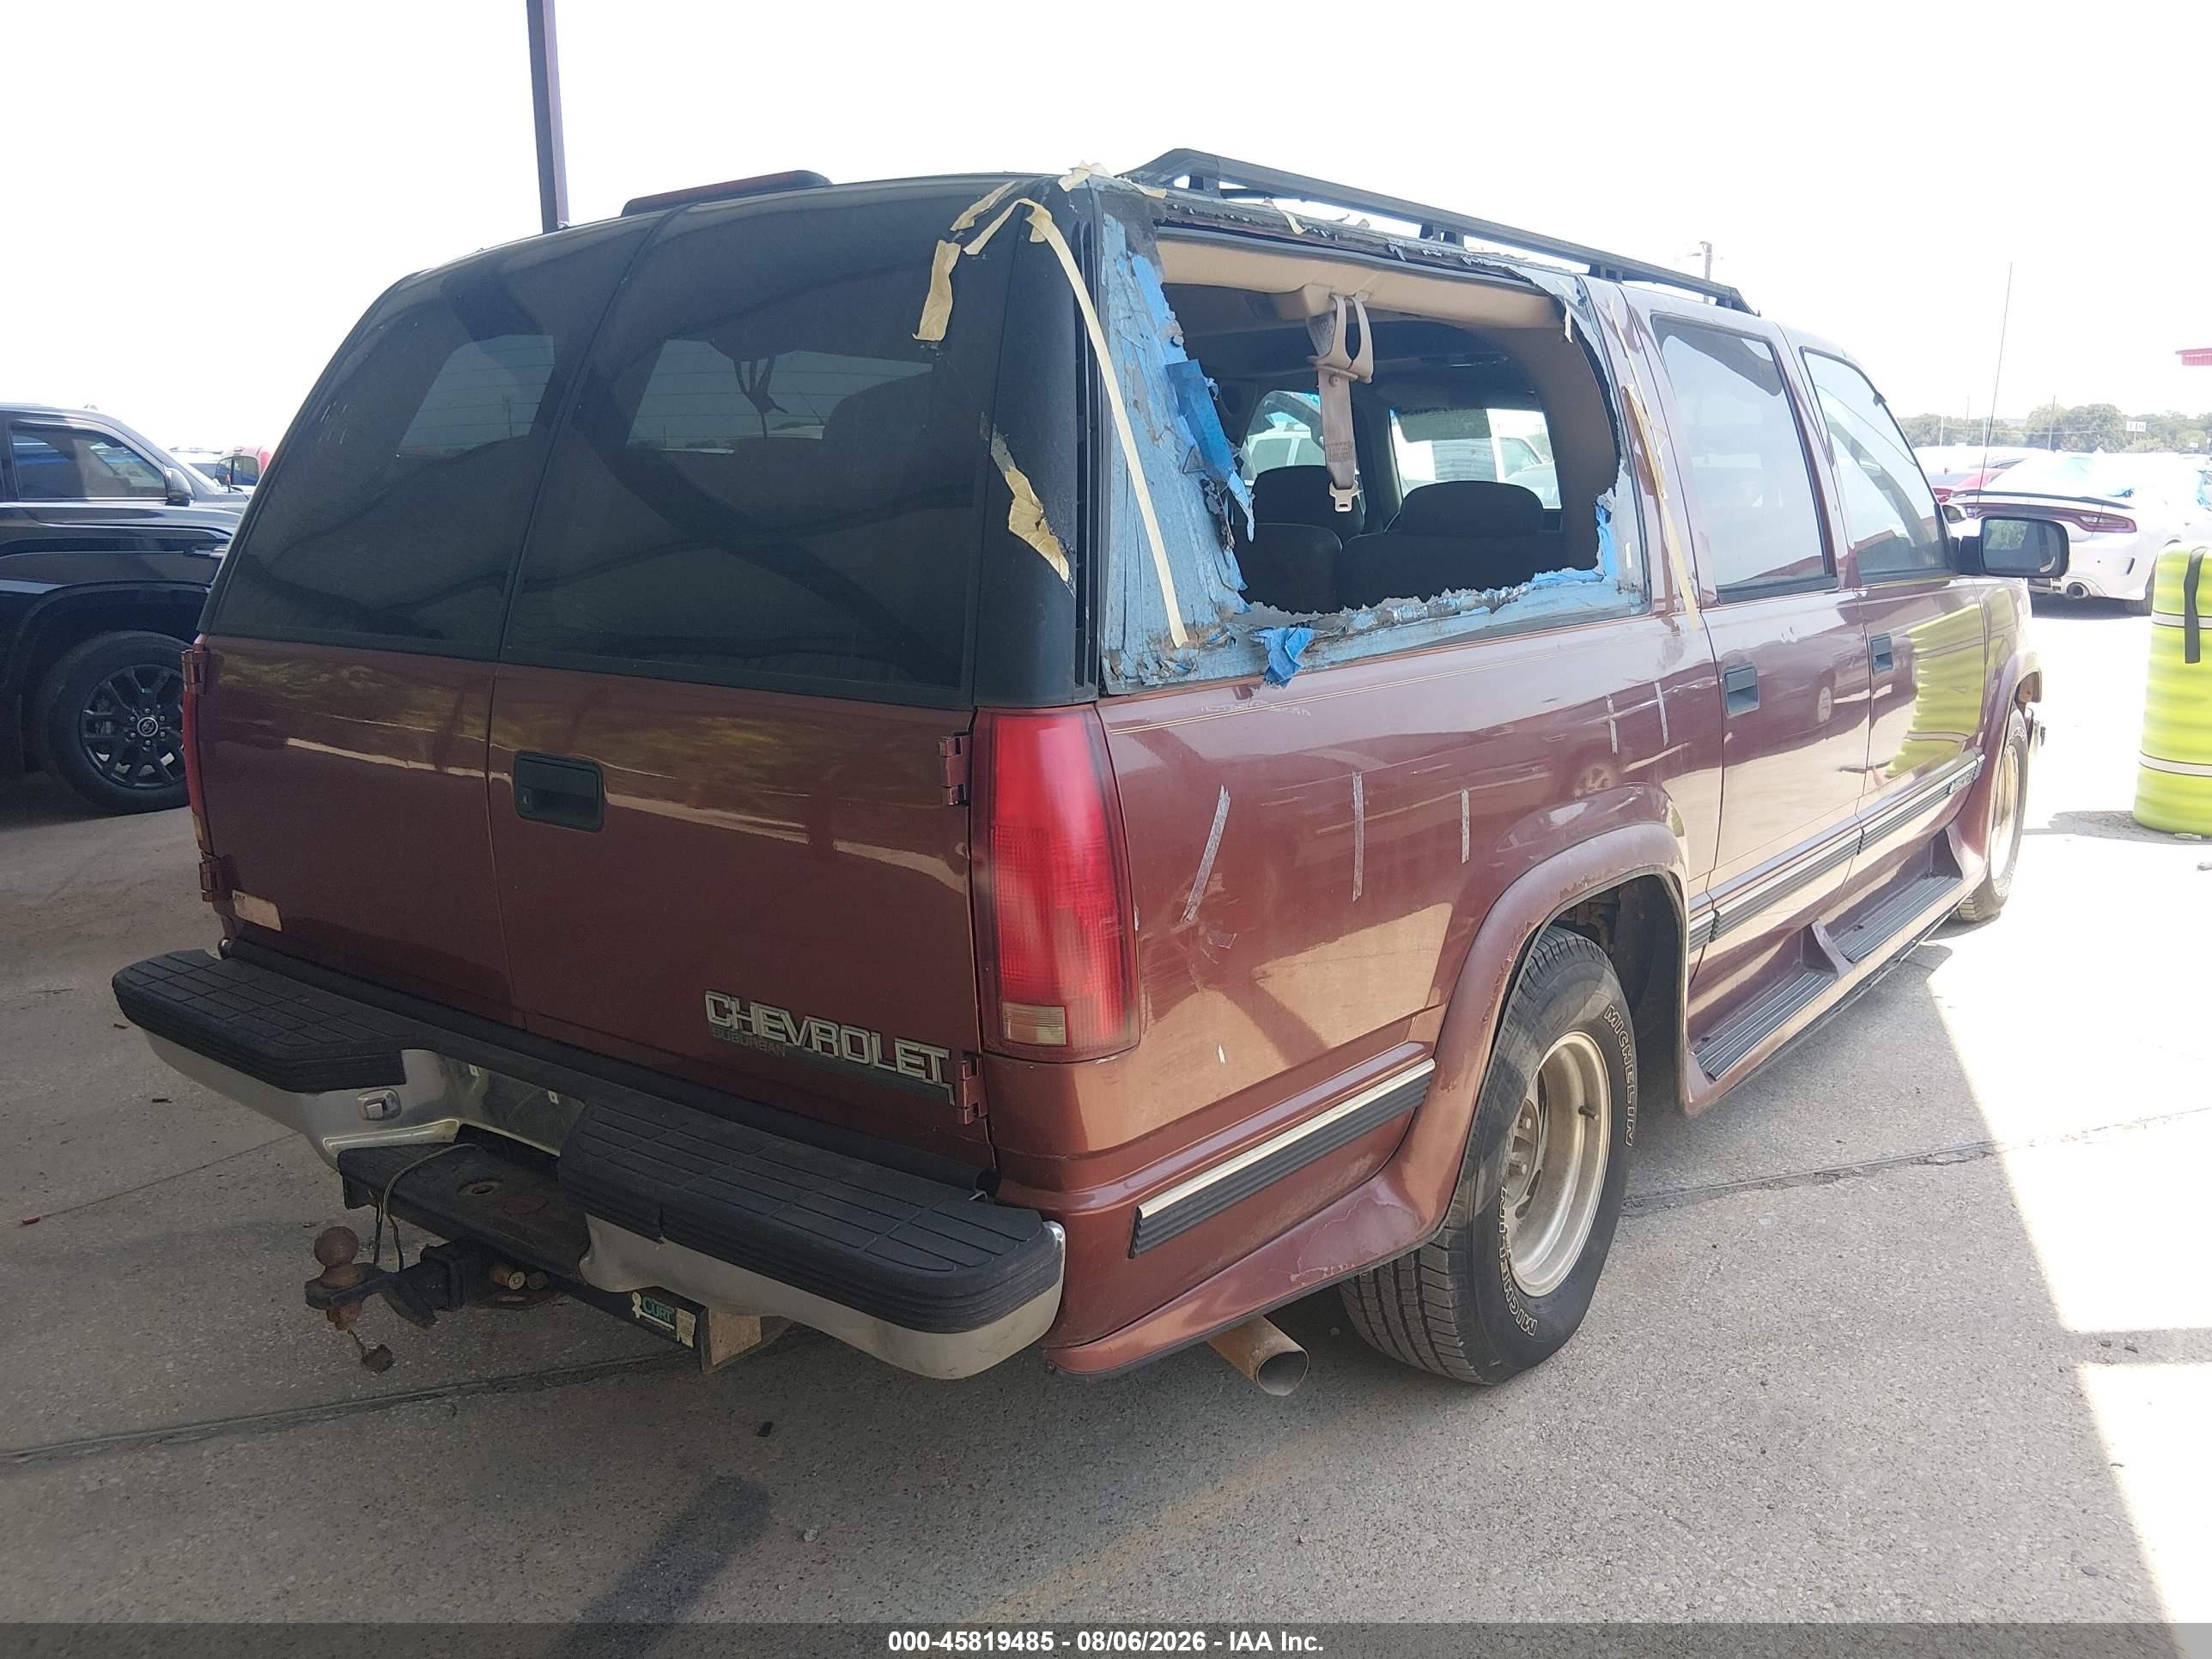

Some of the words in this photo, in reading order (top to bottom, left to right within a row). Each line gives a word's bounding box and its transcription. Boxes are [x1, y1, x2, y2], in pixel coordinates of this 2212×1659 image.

[705, 990, 950, 1084] CHEVROLET
[712, 1028, 785, 1057] SUBURBAN
[1603, 1006, 1636, 1146] MICHELIN
[642, 1297, 674, 1322] CURT
